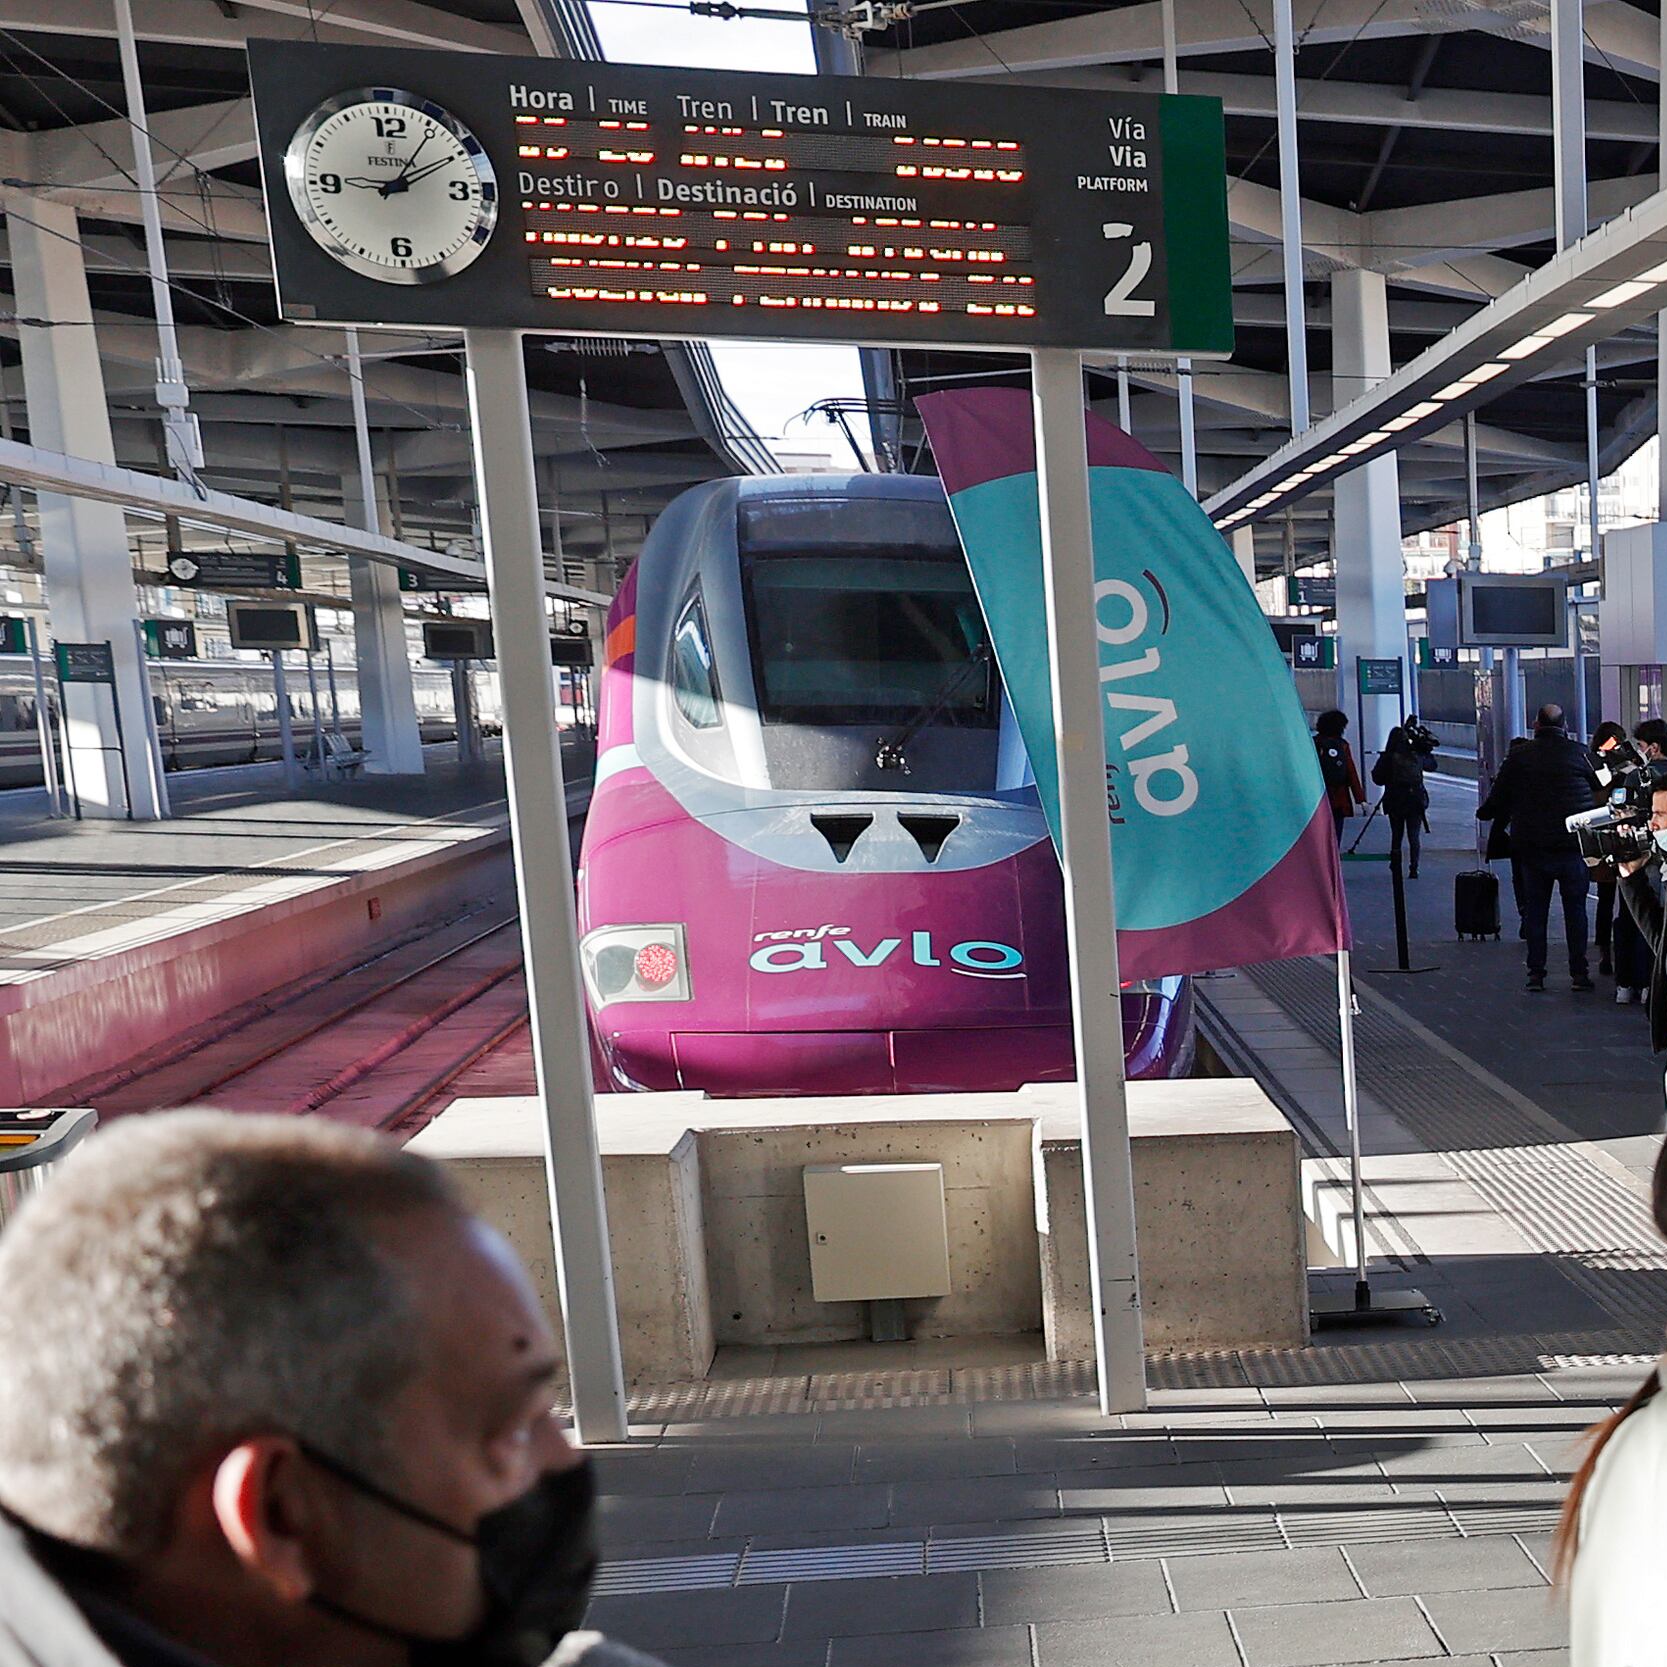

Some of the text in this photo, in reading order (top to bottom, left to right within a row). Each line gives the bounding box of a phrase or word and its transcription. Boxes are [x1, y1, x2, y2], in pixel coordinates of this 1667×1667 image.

[510, 85, 907, 129] Hora TIME Tren Tren TRAIN
[371, 116, 407, 139] 12
[1109, 117, 1146, 141] Vía
[1109, 145, 1147, 168] Via
[319, 173, 343, 194] 9
[448, 181, 470, 201] 3
[657, 178, 798, 207] Destinació
[825, 194, 917, 212] DESTINATION
[1077, 176, 1149, 192] PLATFORM
[390, 237, 413, 258] 6
[1102, 222, 1156, 317] 2
[1093, 578, 1199, 817] avlo
[753, 923, 852, 943] renfe
[749, 930, 1024, 973] avlo
